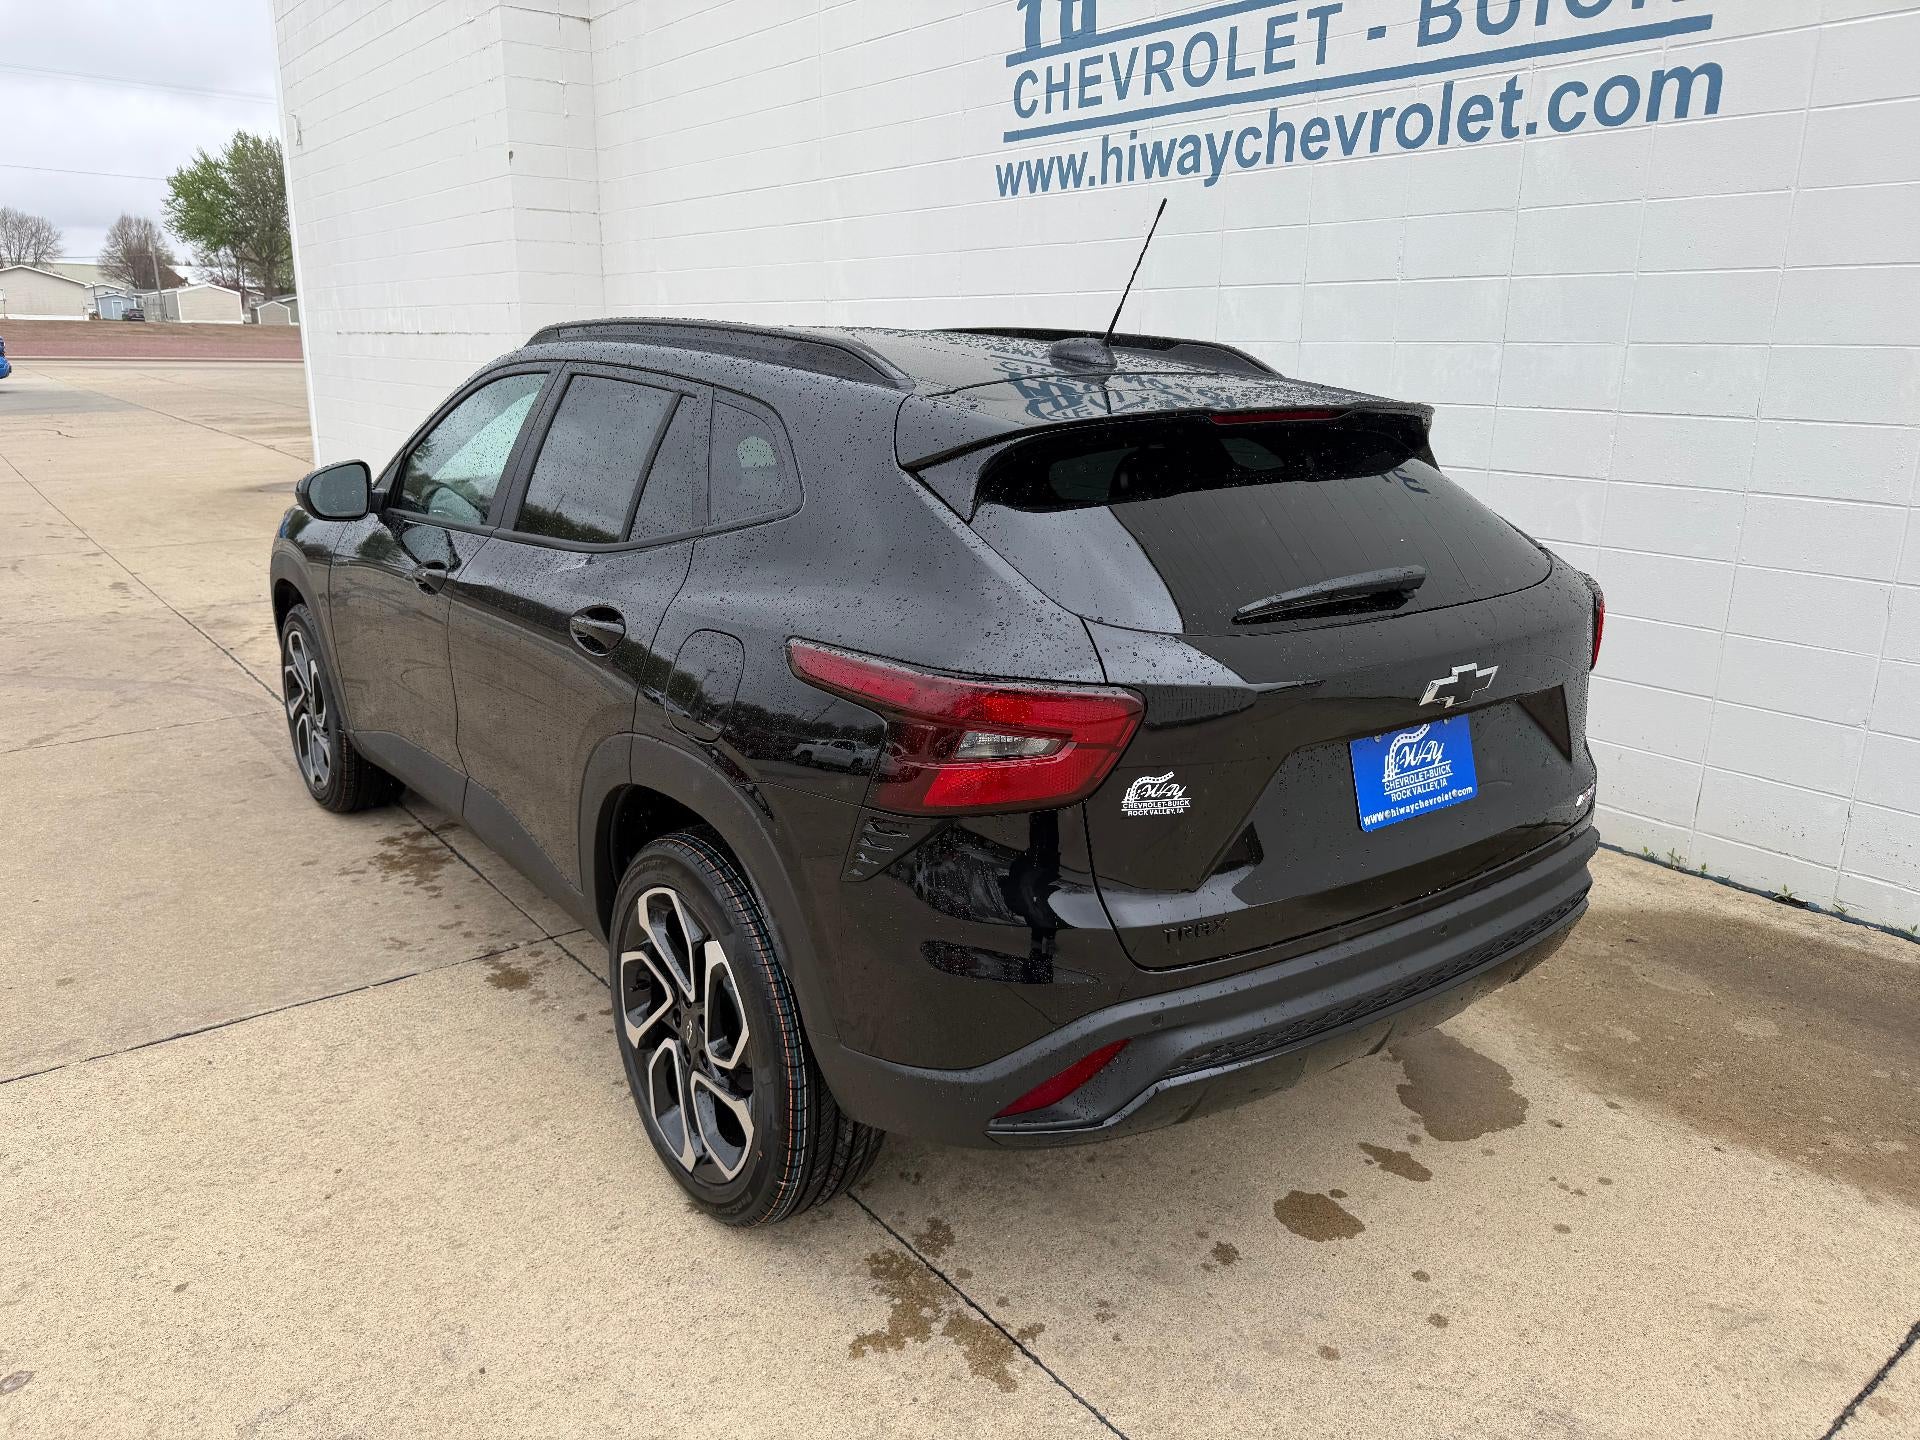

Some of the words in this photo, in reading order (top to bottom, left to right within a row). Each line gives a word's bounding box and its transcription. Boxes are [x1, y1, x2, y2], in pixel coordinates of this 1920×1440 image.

[1013, 2, 1343, 119] CHEVROLET
[995, 61, 1724, 198] www.hiwaychevrolet.com
[1384, 764, 1452, 792] CHEVROLET-BUICK
[1391, 789, 1413, 802] ROCK
[1412, 780, 1440, 796] VALLEY,
[1440, 777, 1448, 788] IA
[1122, 800, 1190, 809] CHEVROLET-BUICK
[1149, 808, 1176, 816] VALLEY,
[1363, 786, 1473, 826] wwwhiwaychevroletcom
